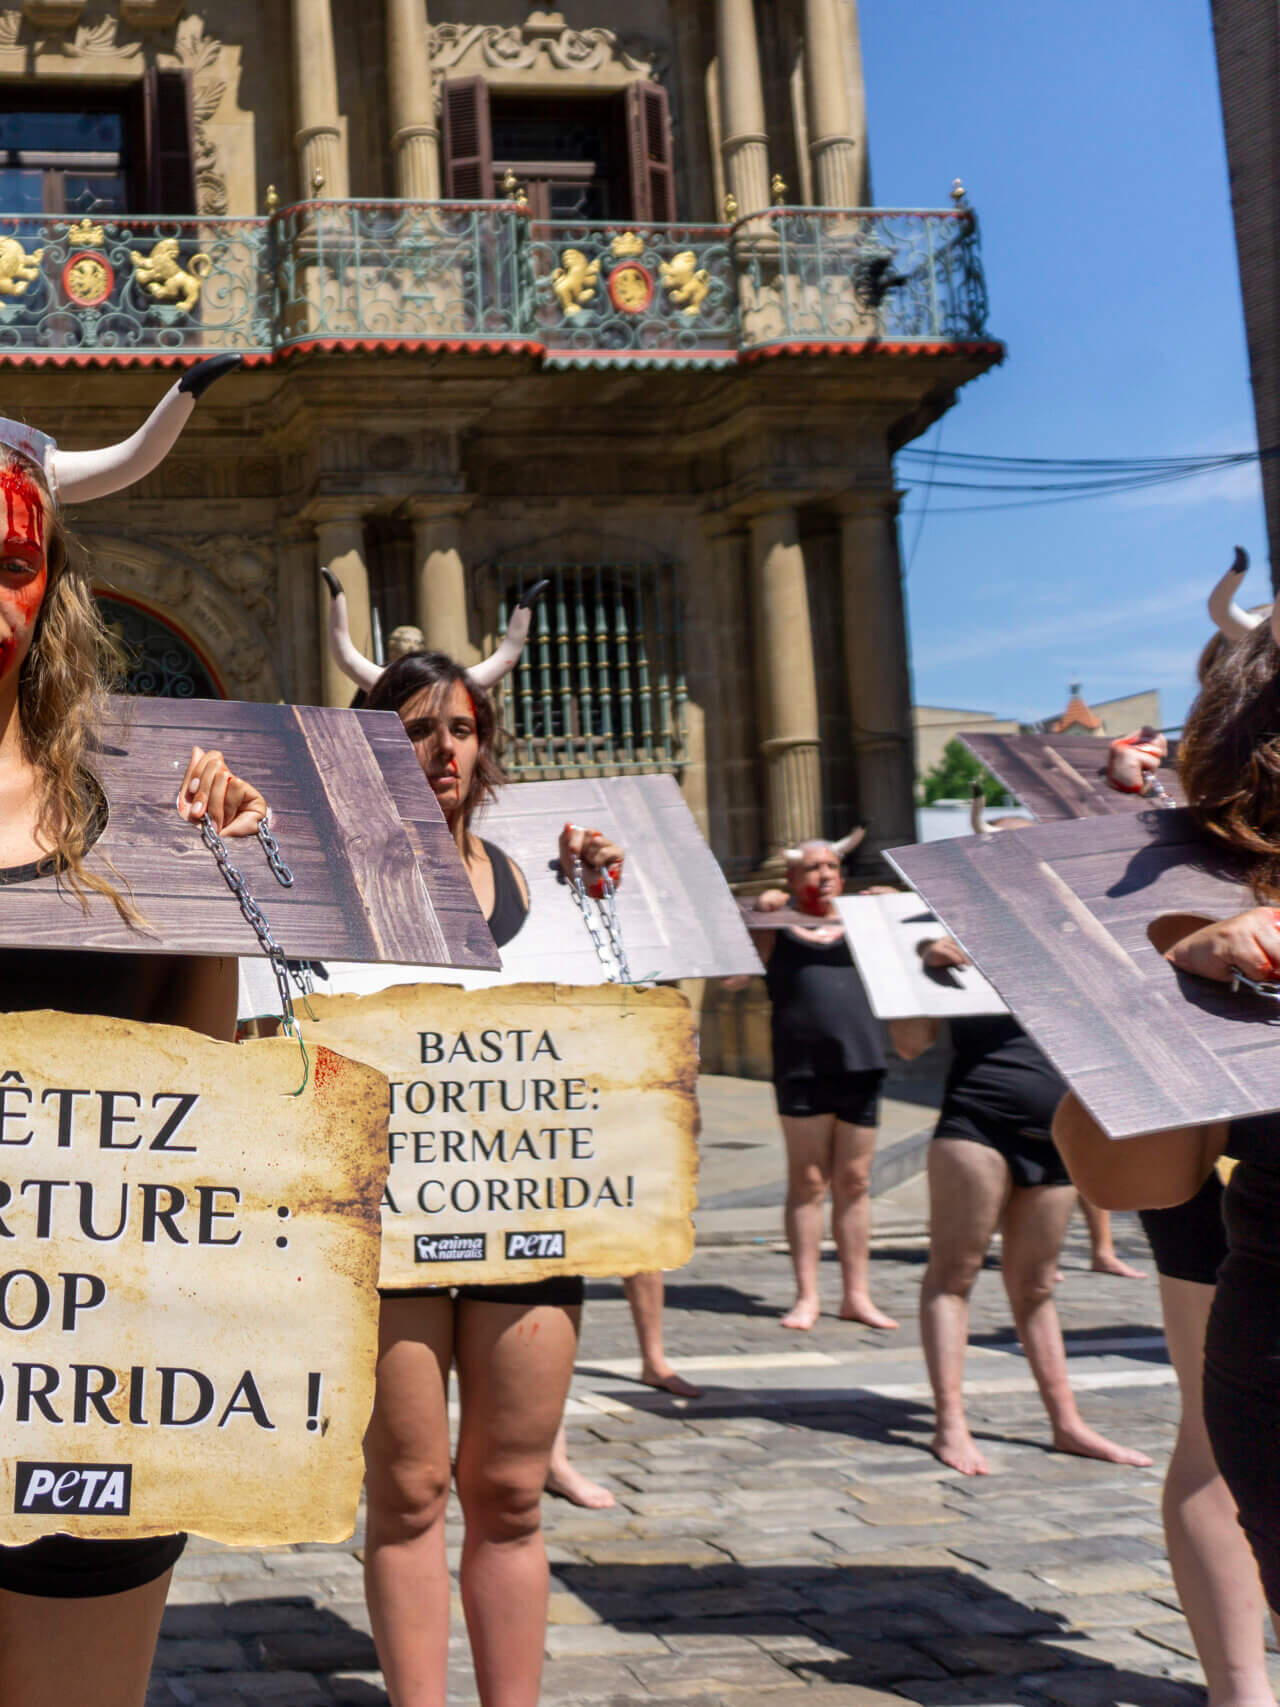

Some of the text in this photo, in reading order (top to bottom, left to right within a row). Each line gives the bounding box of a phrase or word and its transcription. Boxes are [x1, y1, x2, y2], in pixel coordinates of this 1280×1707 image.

[417, 1029, 562, 1064] BASTA
[388, 1078, 599, 1115] TORTURE:
[388, 1127, 594, 1164] FERMATE
[417, 1175, 634, 1214] CORRIDA!
[275, 1205, 291, 1249] :
[438, 1235, 483, 1250] anima
[305, 1372, 322, 1432] !
